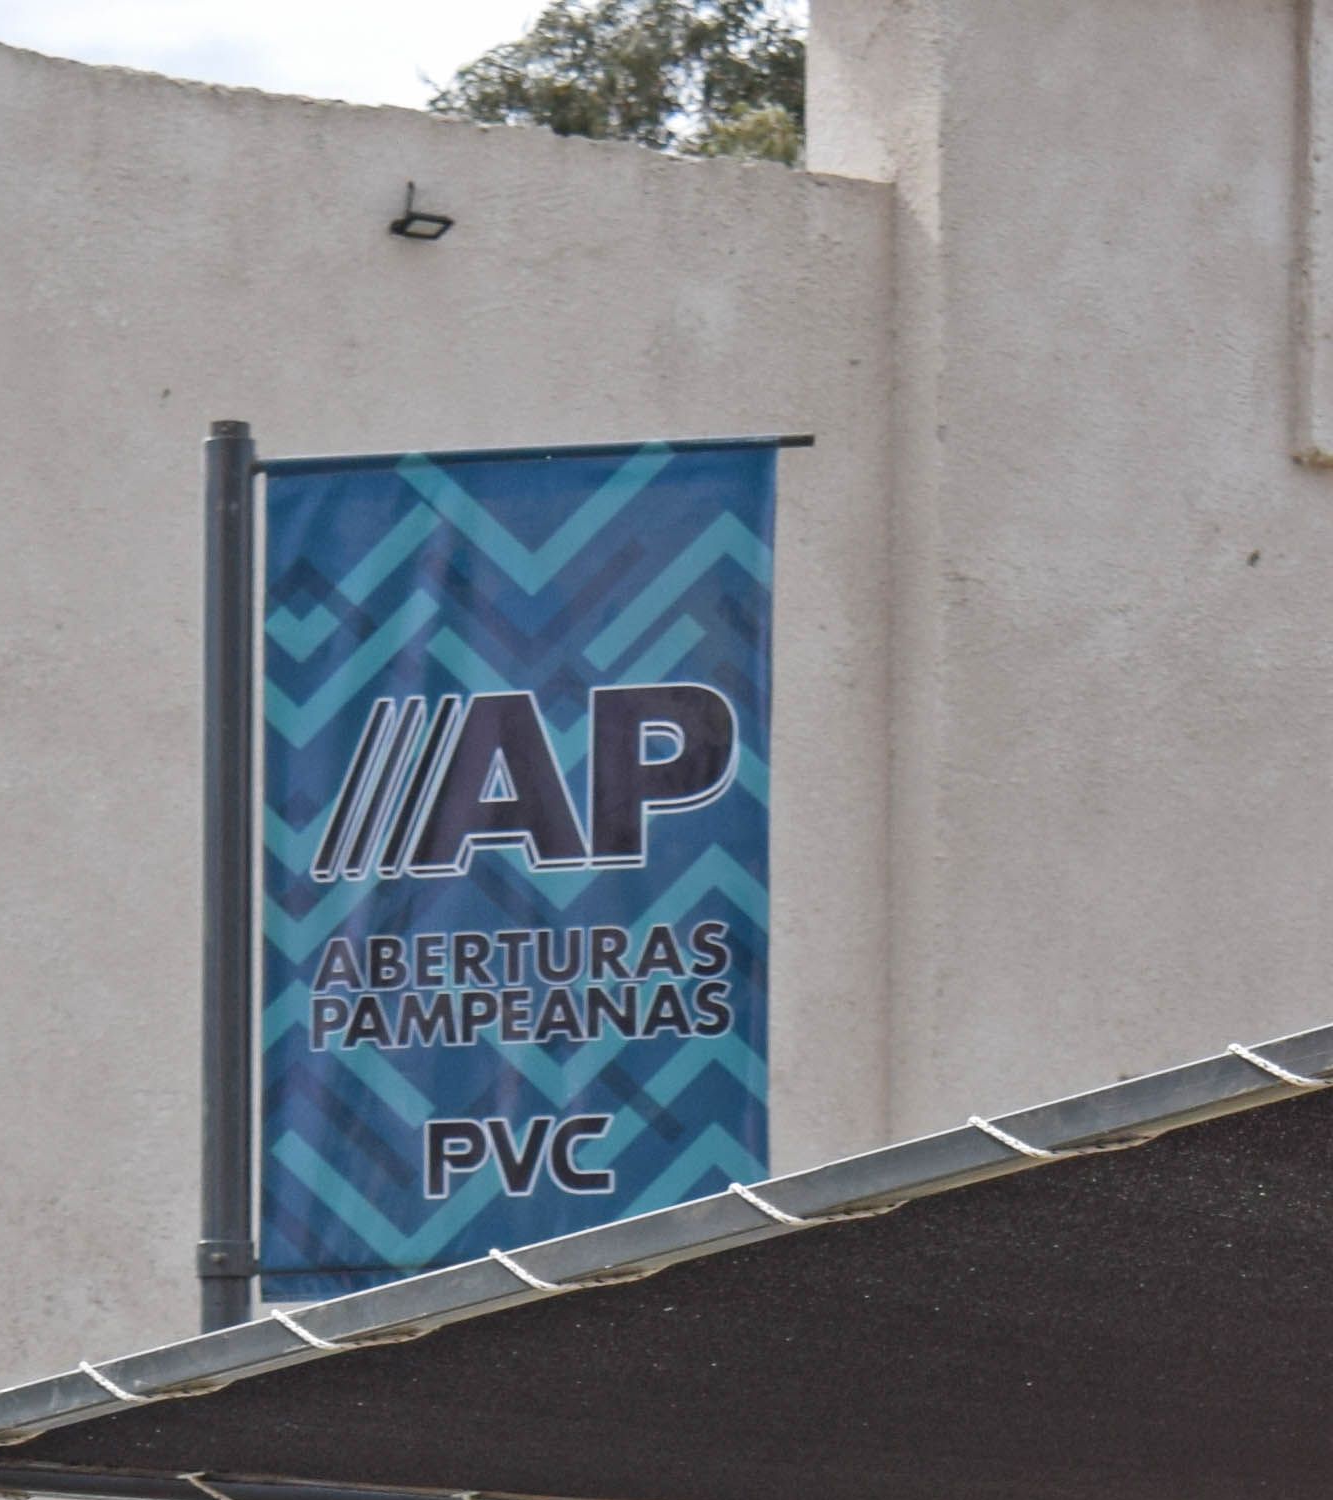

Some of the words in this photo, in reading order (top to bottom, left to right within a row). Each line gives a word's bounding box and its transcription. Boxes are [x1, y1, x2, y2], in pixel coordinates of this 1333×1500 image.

[313, 921, 731, 994] ABERTURAS
[310, 980, 731, 1052] PAMPEANAS
[424, 1115, 614, 1198] PVC
